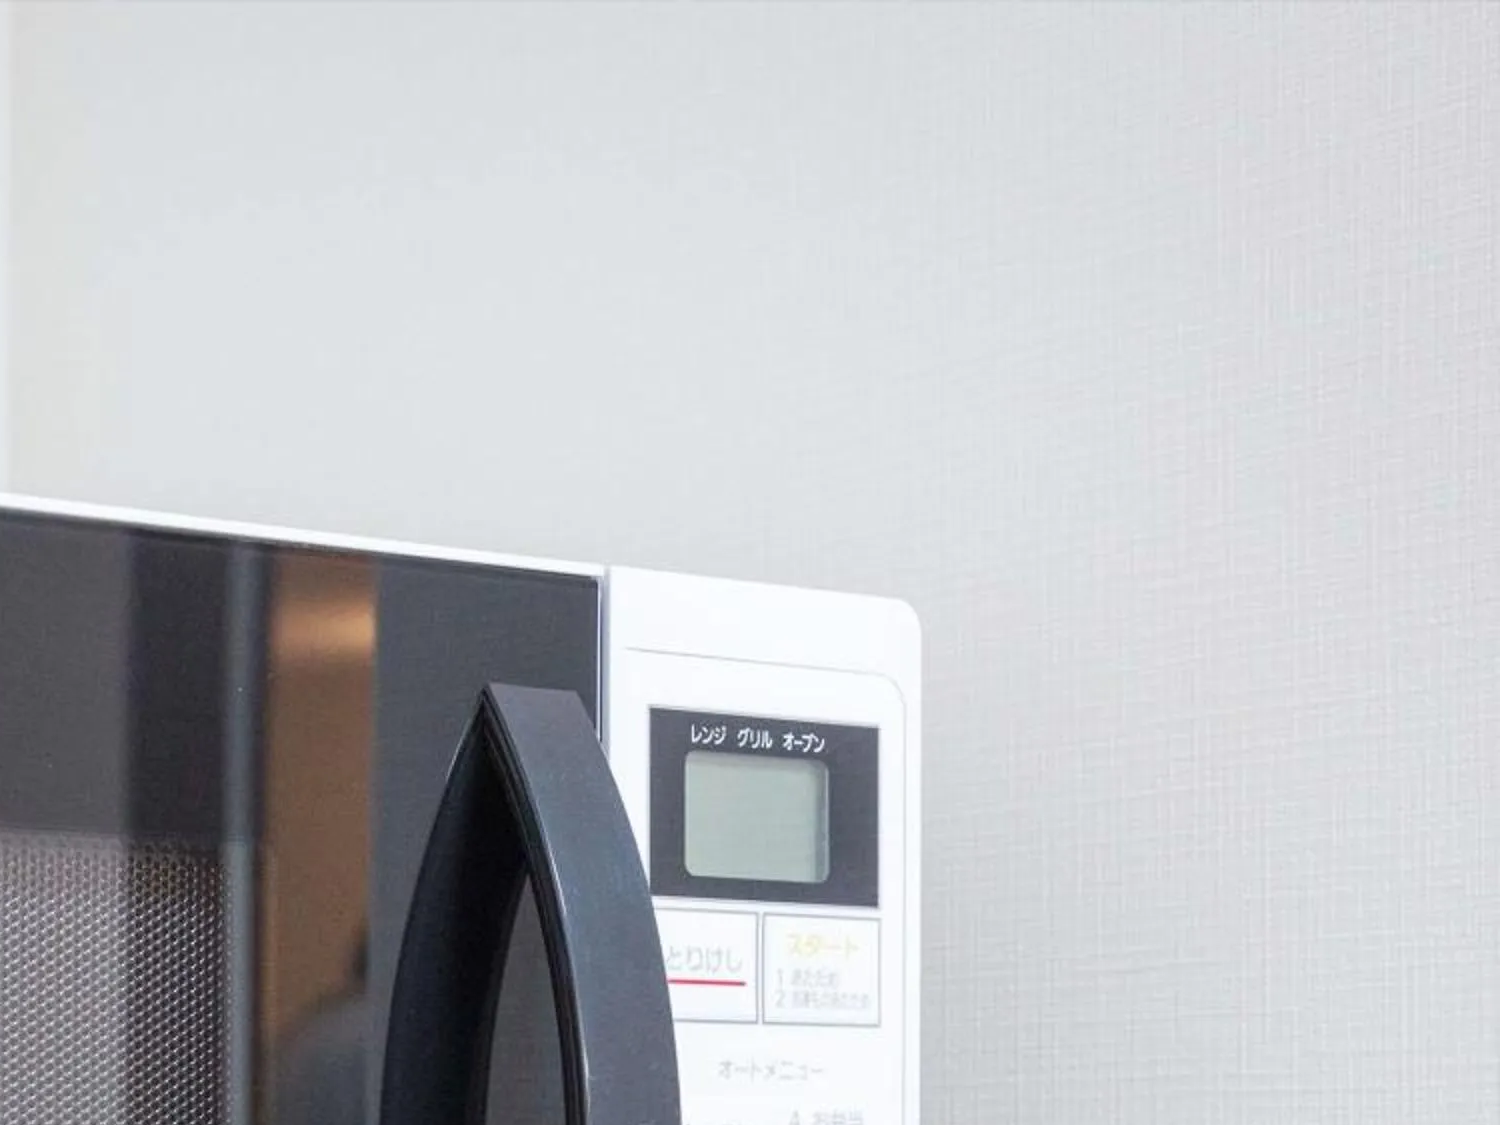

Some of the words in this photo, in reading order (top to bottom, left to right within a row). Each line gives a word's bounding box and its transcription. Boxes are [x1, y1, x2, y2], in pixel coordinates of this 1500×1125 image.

[690, 724, 727, 745] レンジ
[737, 728, 773, 749] グリル
[667, 945, 743, 973] とりけし
[786, 932, 860, 960] スタート
[718, 1059, 825, 1082] オートメニュー
